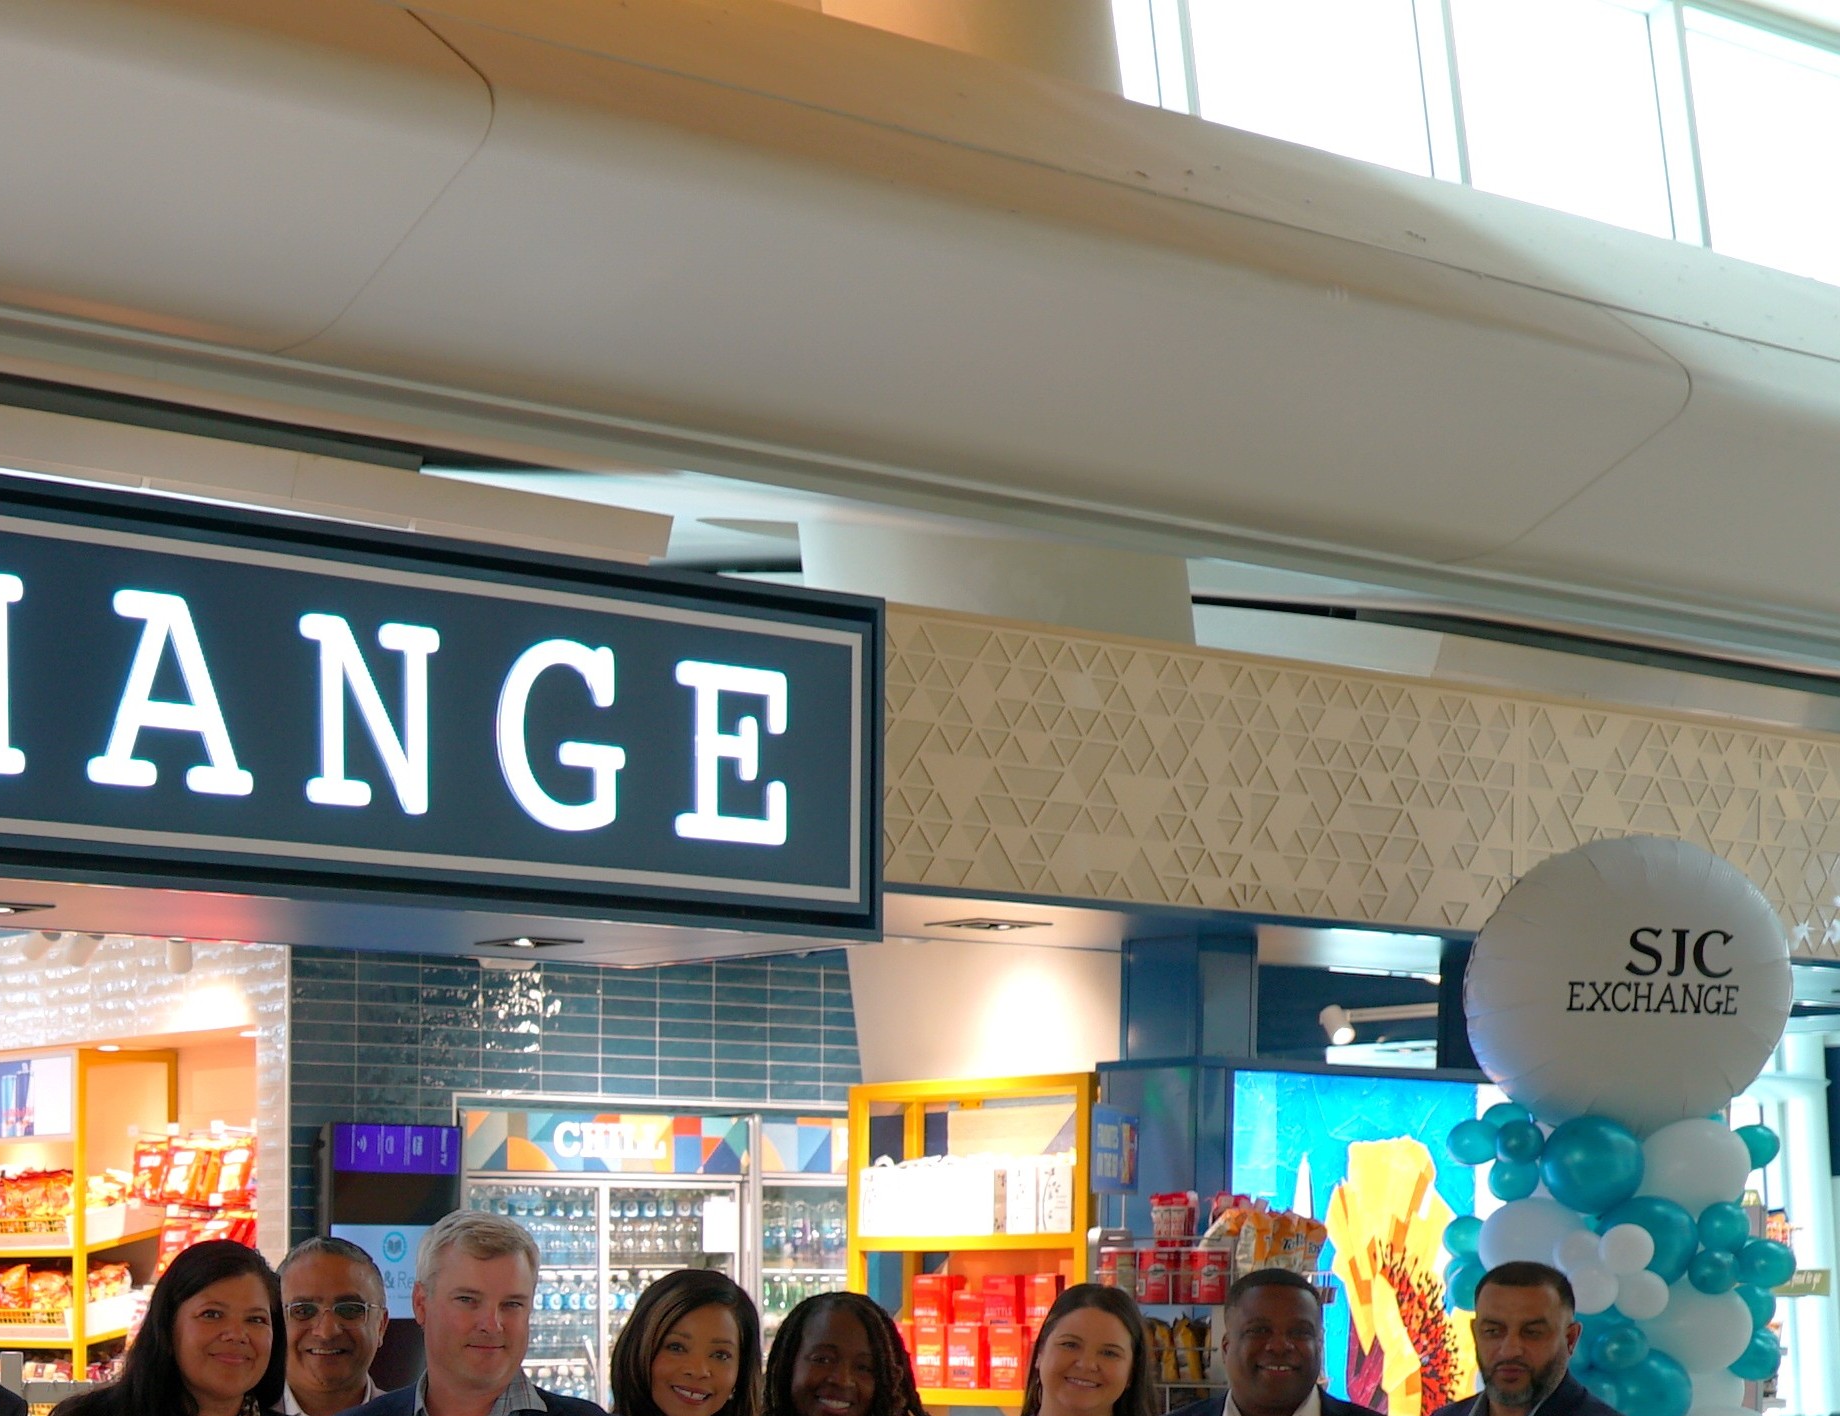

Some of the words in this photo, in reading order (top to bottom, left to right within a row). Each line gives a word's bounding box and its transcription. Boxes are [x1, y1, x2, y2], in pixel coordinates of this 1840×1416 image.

[1625, 926, 1734, 978] SJC
[1566, 981, 1740, 1016] EXCHANGE
[553, 1121, 667, 1160] CHILL
